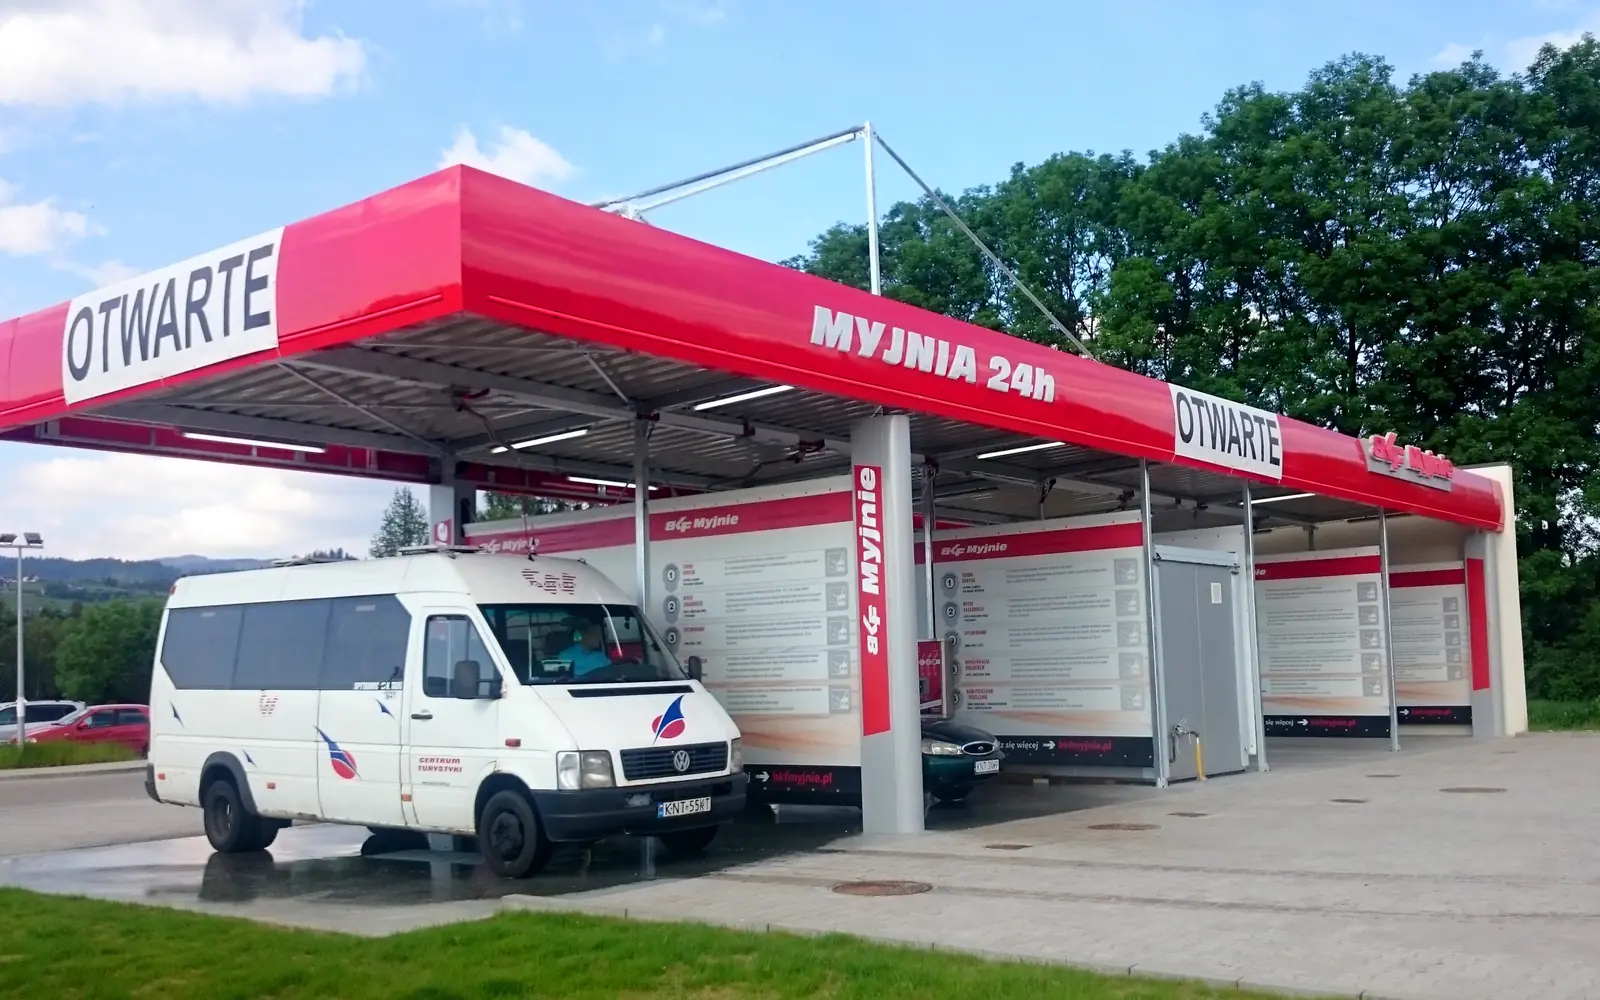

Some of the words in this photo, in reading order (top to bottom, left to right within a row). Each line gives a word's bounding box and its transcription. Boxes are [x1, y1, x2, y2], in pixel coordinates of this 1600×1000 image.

[67, 243, 275, 382] OTWARTE
[810, 305, 977, 383] MYJNIA
[987, 355, 1055, 403] 24h
[1176, 391, 1280, 467] OTWARTE
[693, 513, 740, 530] Myjnie
[858, 467, 882, 595] Myjnie
[966, 542, 1008, 554] Myjnie
[1016, 740, 1039, 751] więcej
[418, 765, 463, 773] TURYSTYKI
